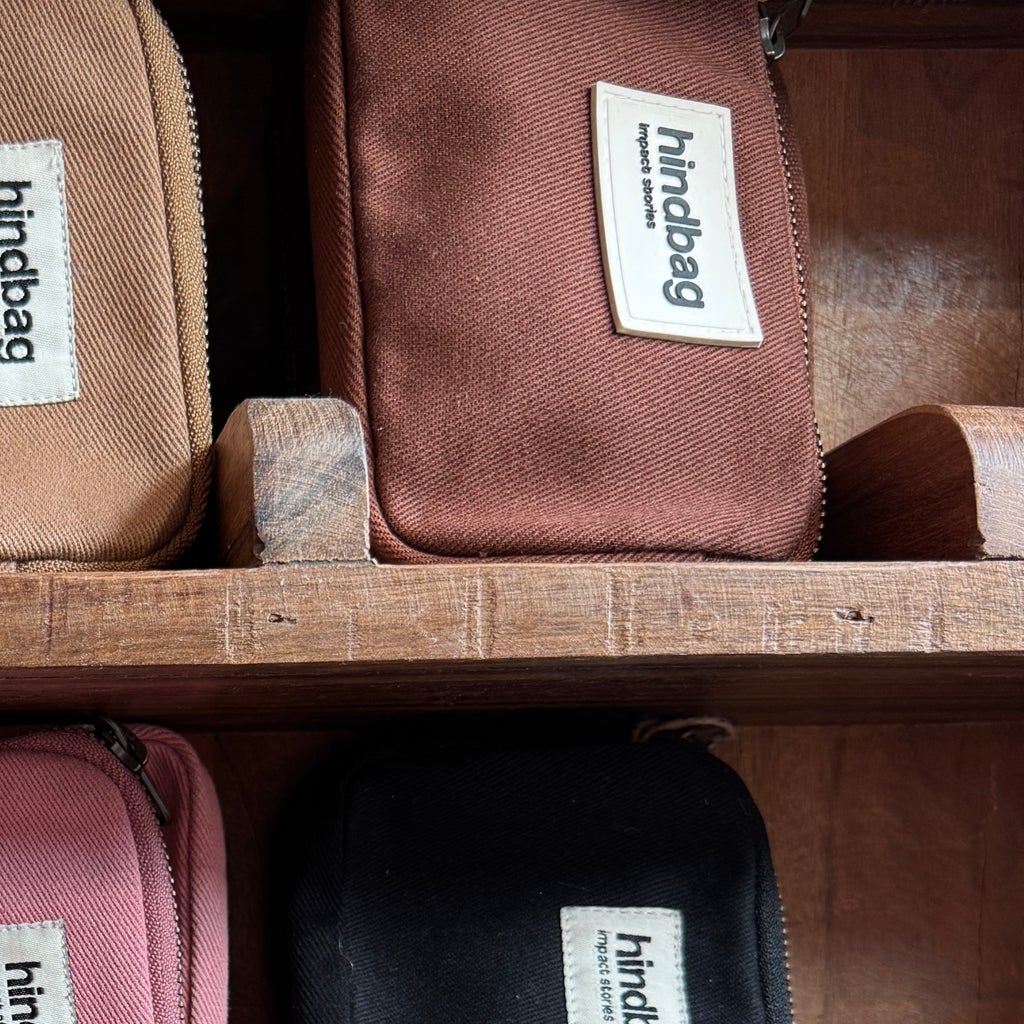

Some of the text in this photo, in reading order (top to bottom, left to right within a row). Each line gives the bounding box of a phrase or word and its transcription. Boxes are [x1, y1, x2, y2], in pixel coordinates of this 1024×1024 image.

[636, 122, 658, 230] impact stories
[657, 126, 705, 309] hindbag
[594, 929, 615, 1023] impact stories
